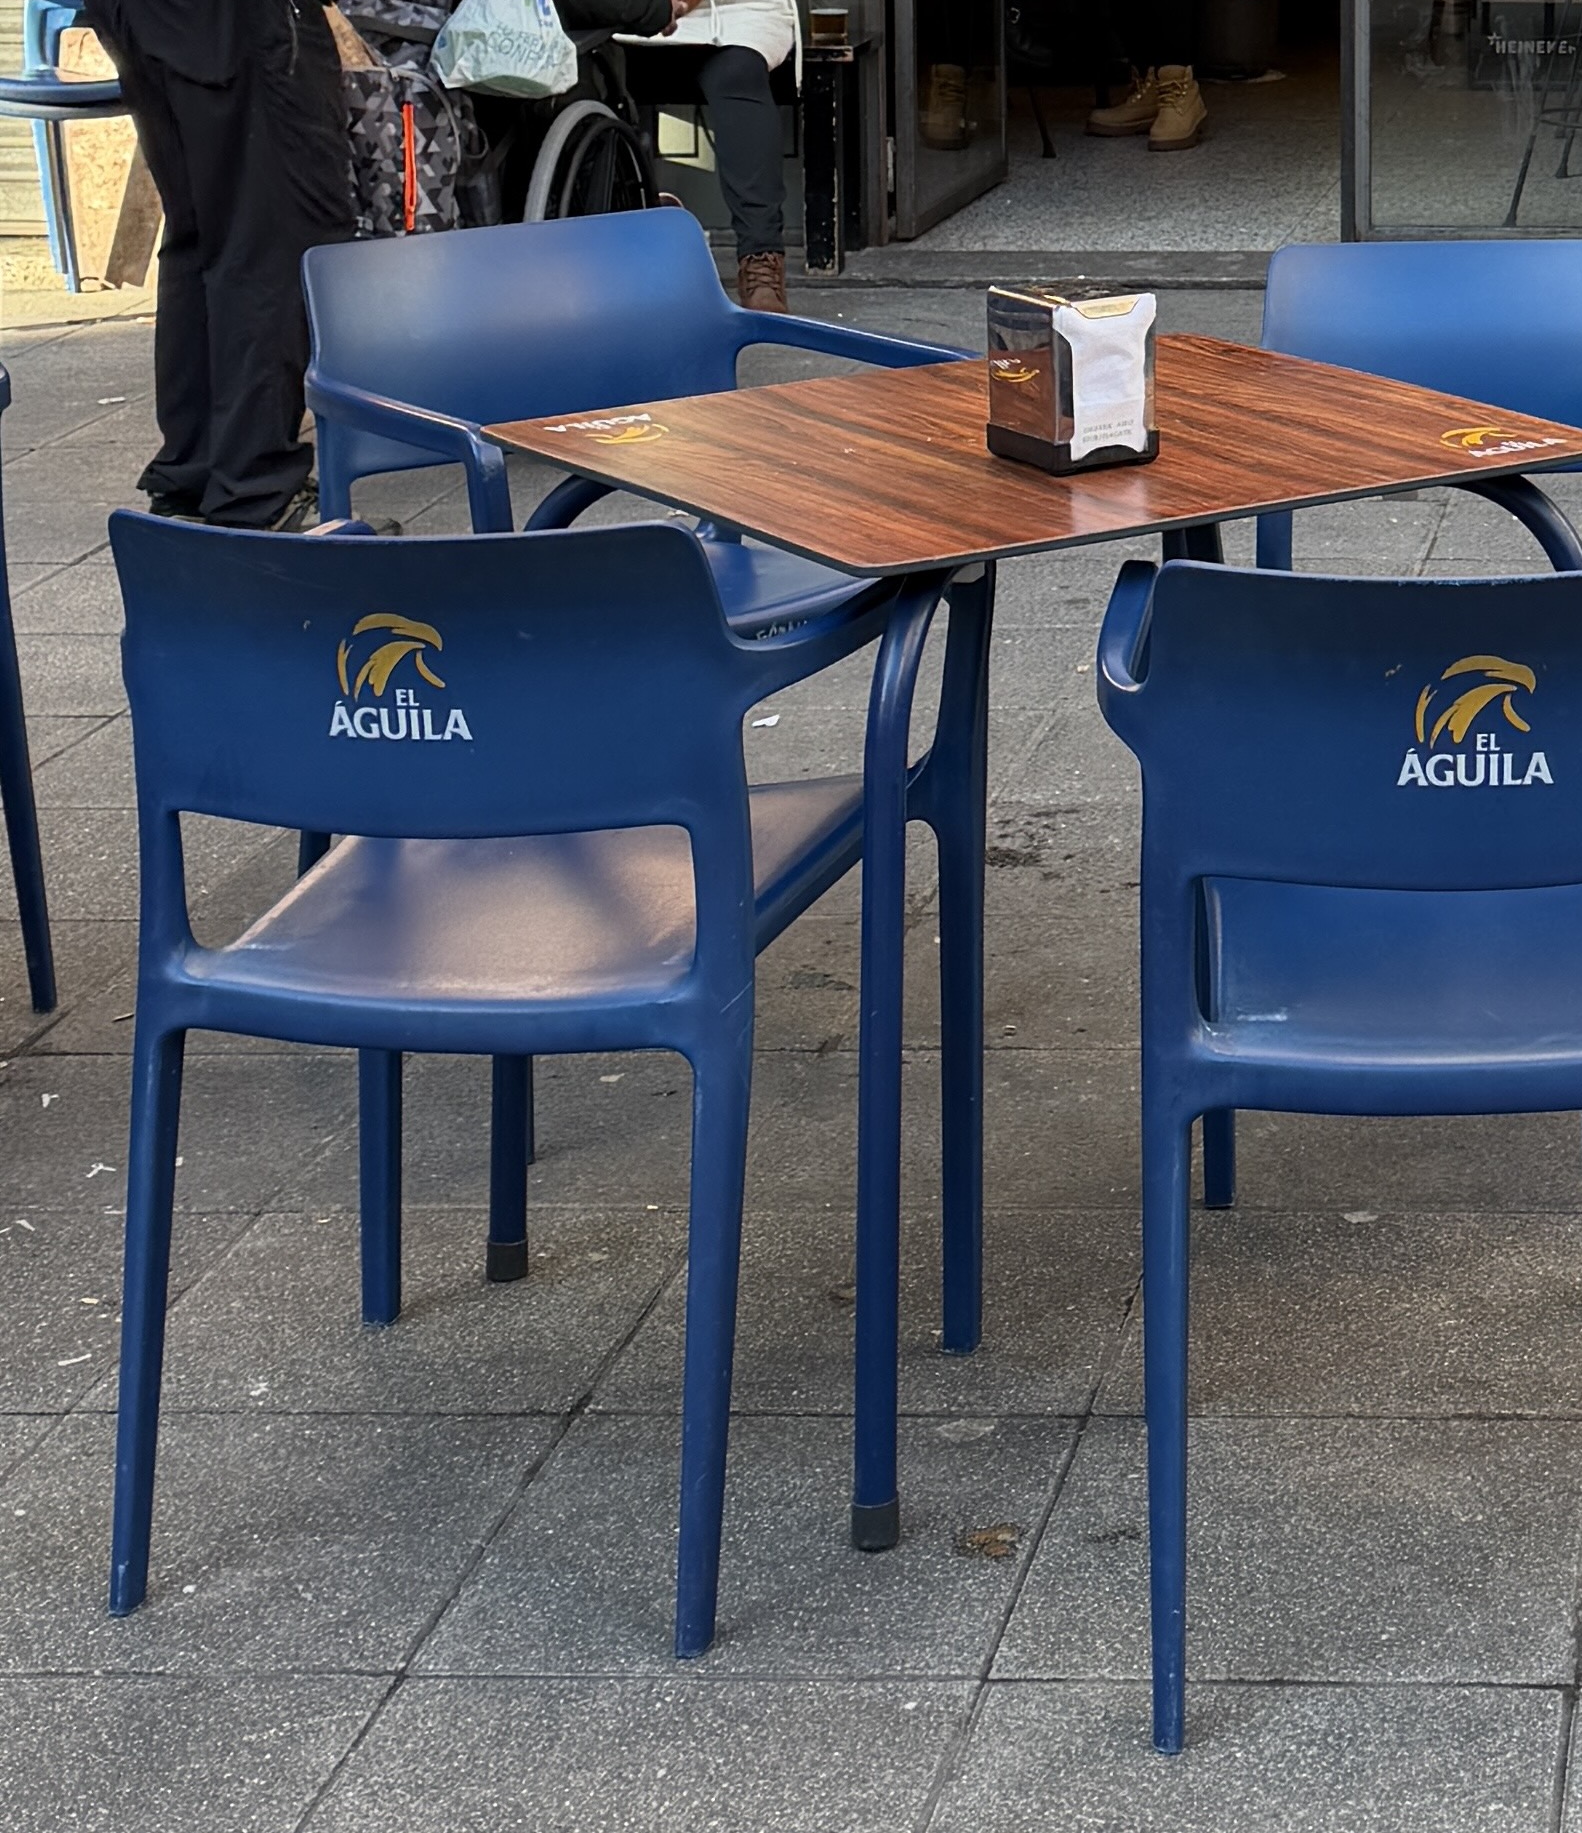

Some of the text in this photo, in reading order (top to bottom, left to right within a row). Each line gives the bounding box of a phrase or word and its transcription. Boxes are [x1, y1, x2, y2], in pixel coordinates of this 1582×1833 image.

[395, 688, 420, 707] EL
[329, 700, 473, 741] ÁGUILA
[1476, 732, 1501, 752] EL
[1396, 747, 1555, 787] ÁGUILA
